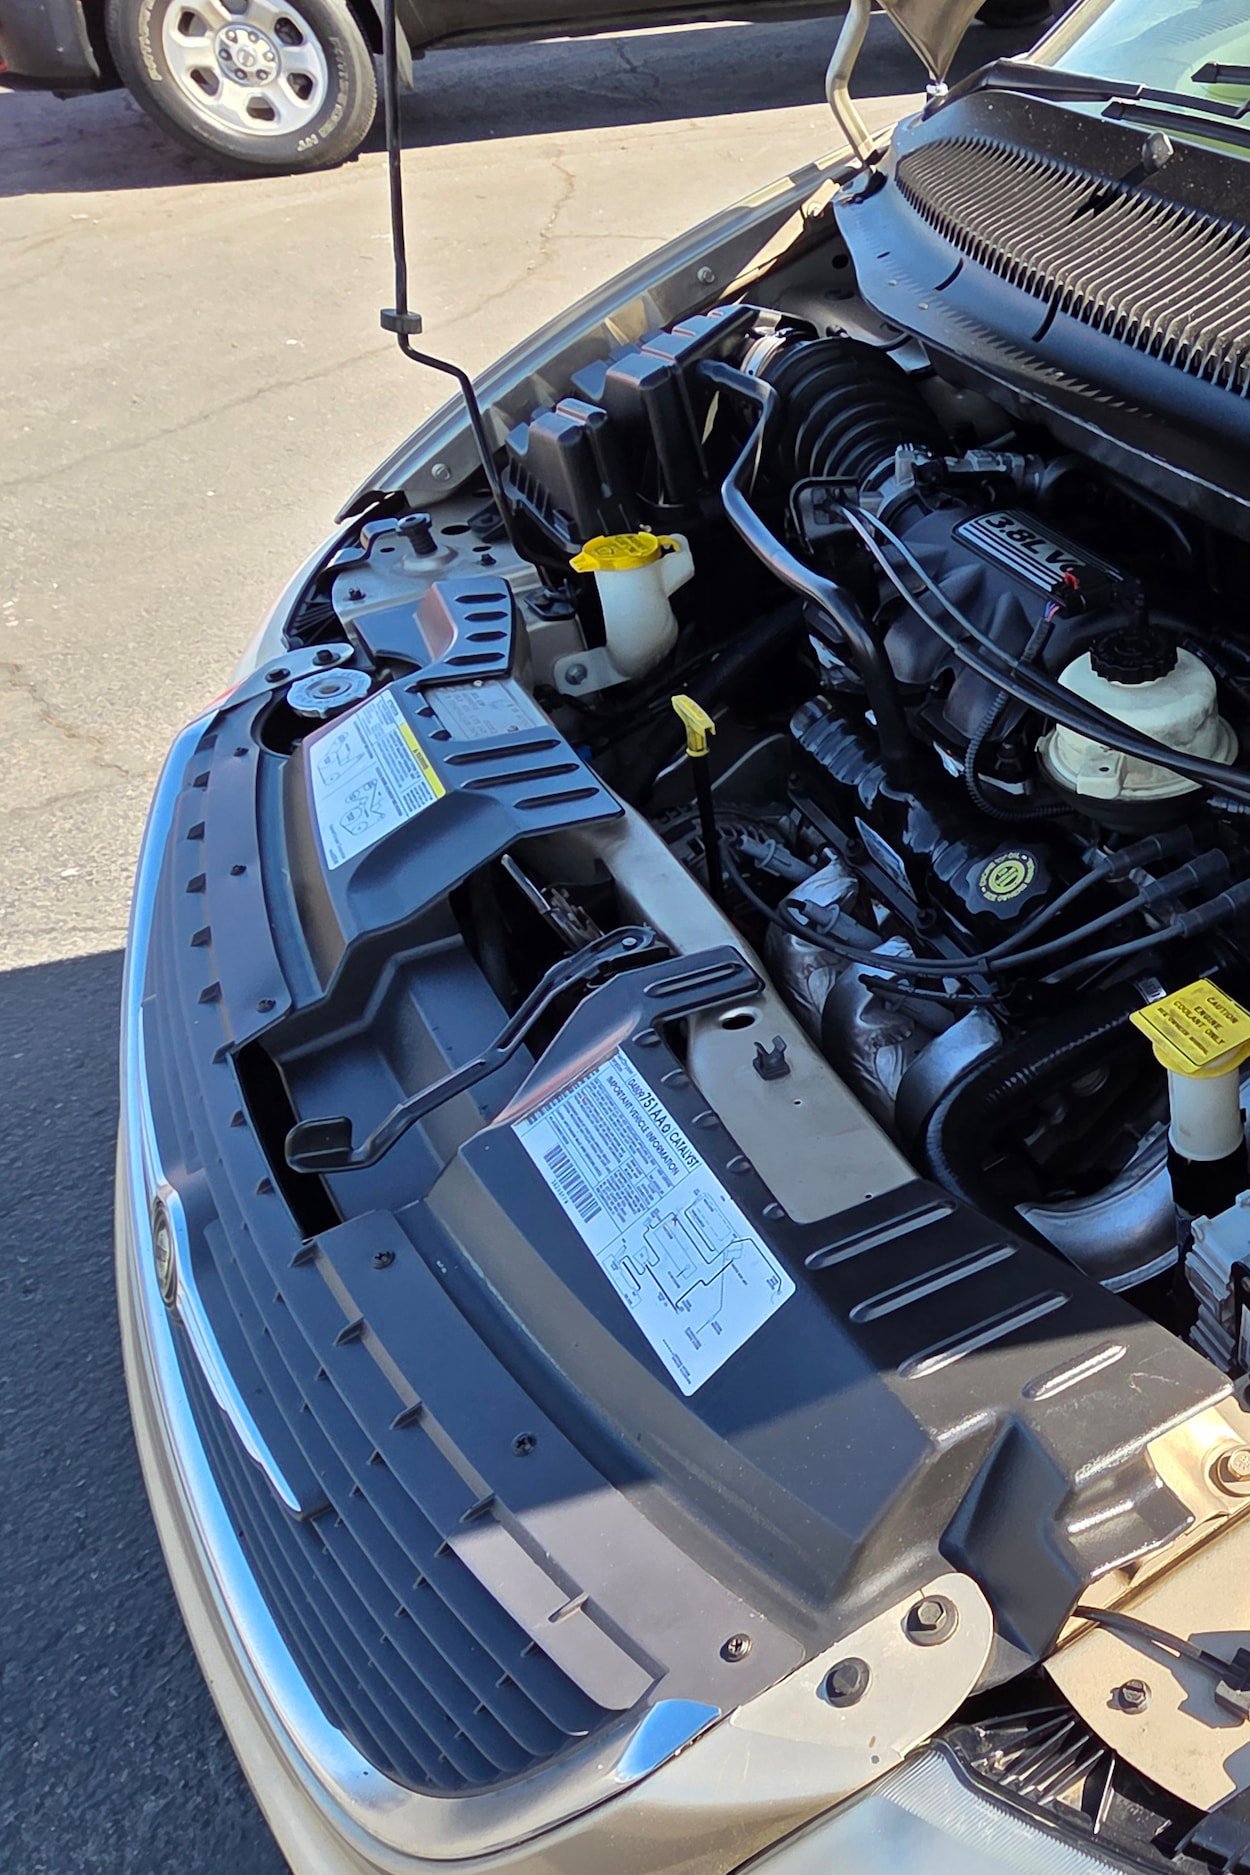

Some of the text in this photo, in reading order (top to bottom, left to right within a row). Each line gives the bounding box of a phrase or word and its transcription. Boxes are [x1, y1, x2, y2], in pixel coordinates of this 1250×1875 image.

[985, 516, 1040, 554] 3.8L
[1171, 1000, 1225, 1045] COOLANT ONLY
[1192, 1005, 1223, 1030] ENGINE
[1205, 996, 1239, 1024] CAUTION
[605, 1075, 633, 1109] IMPORTANT
[645, 1130, 680, 1176] INFORMATION
[667, 1130, 699, 1169] CATALYST
